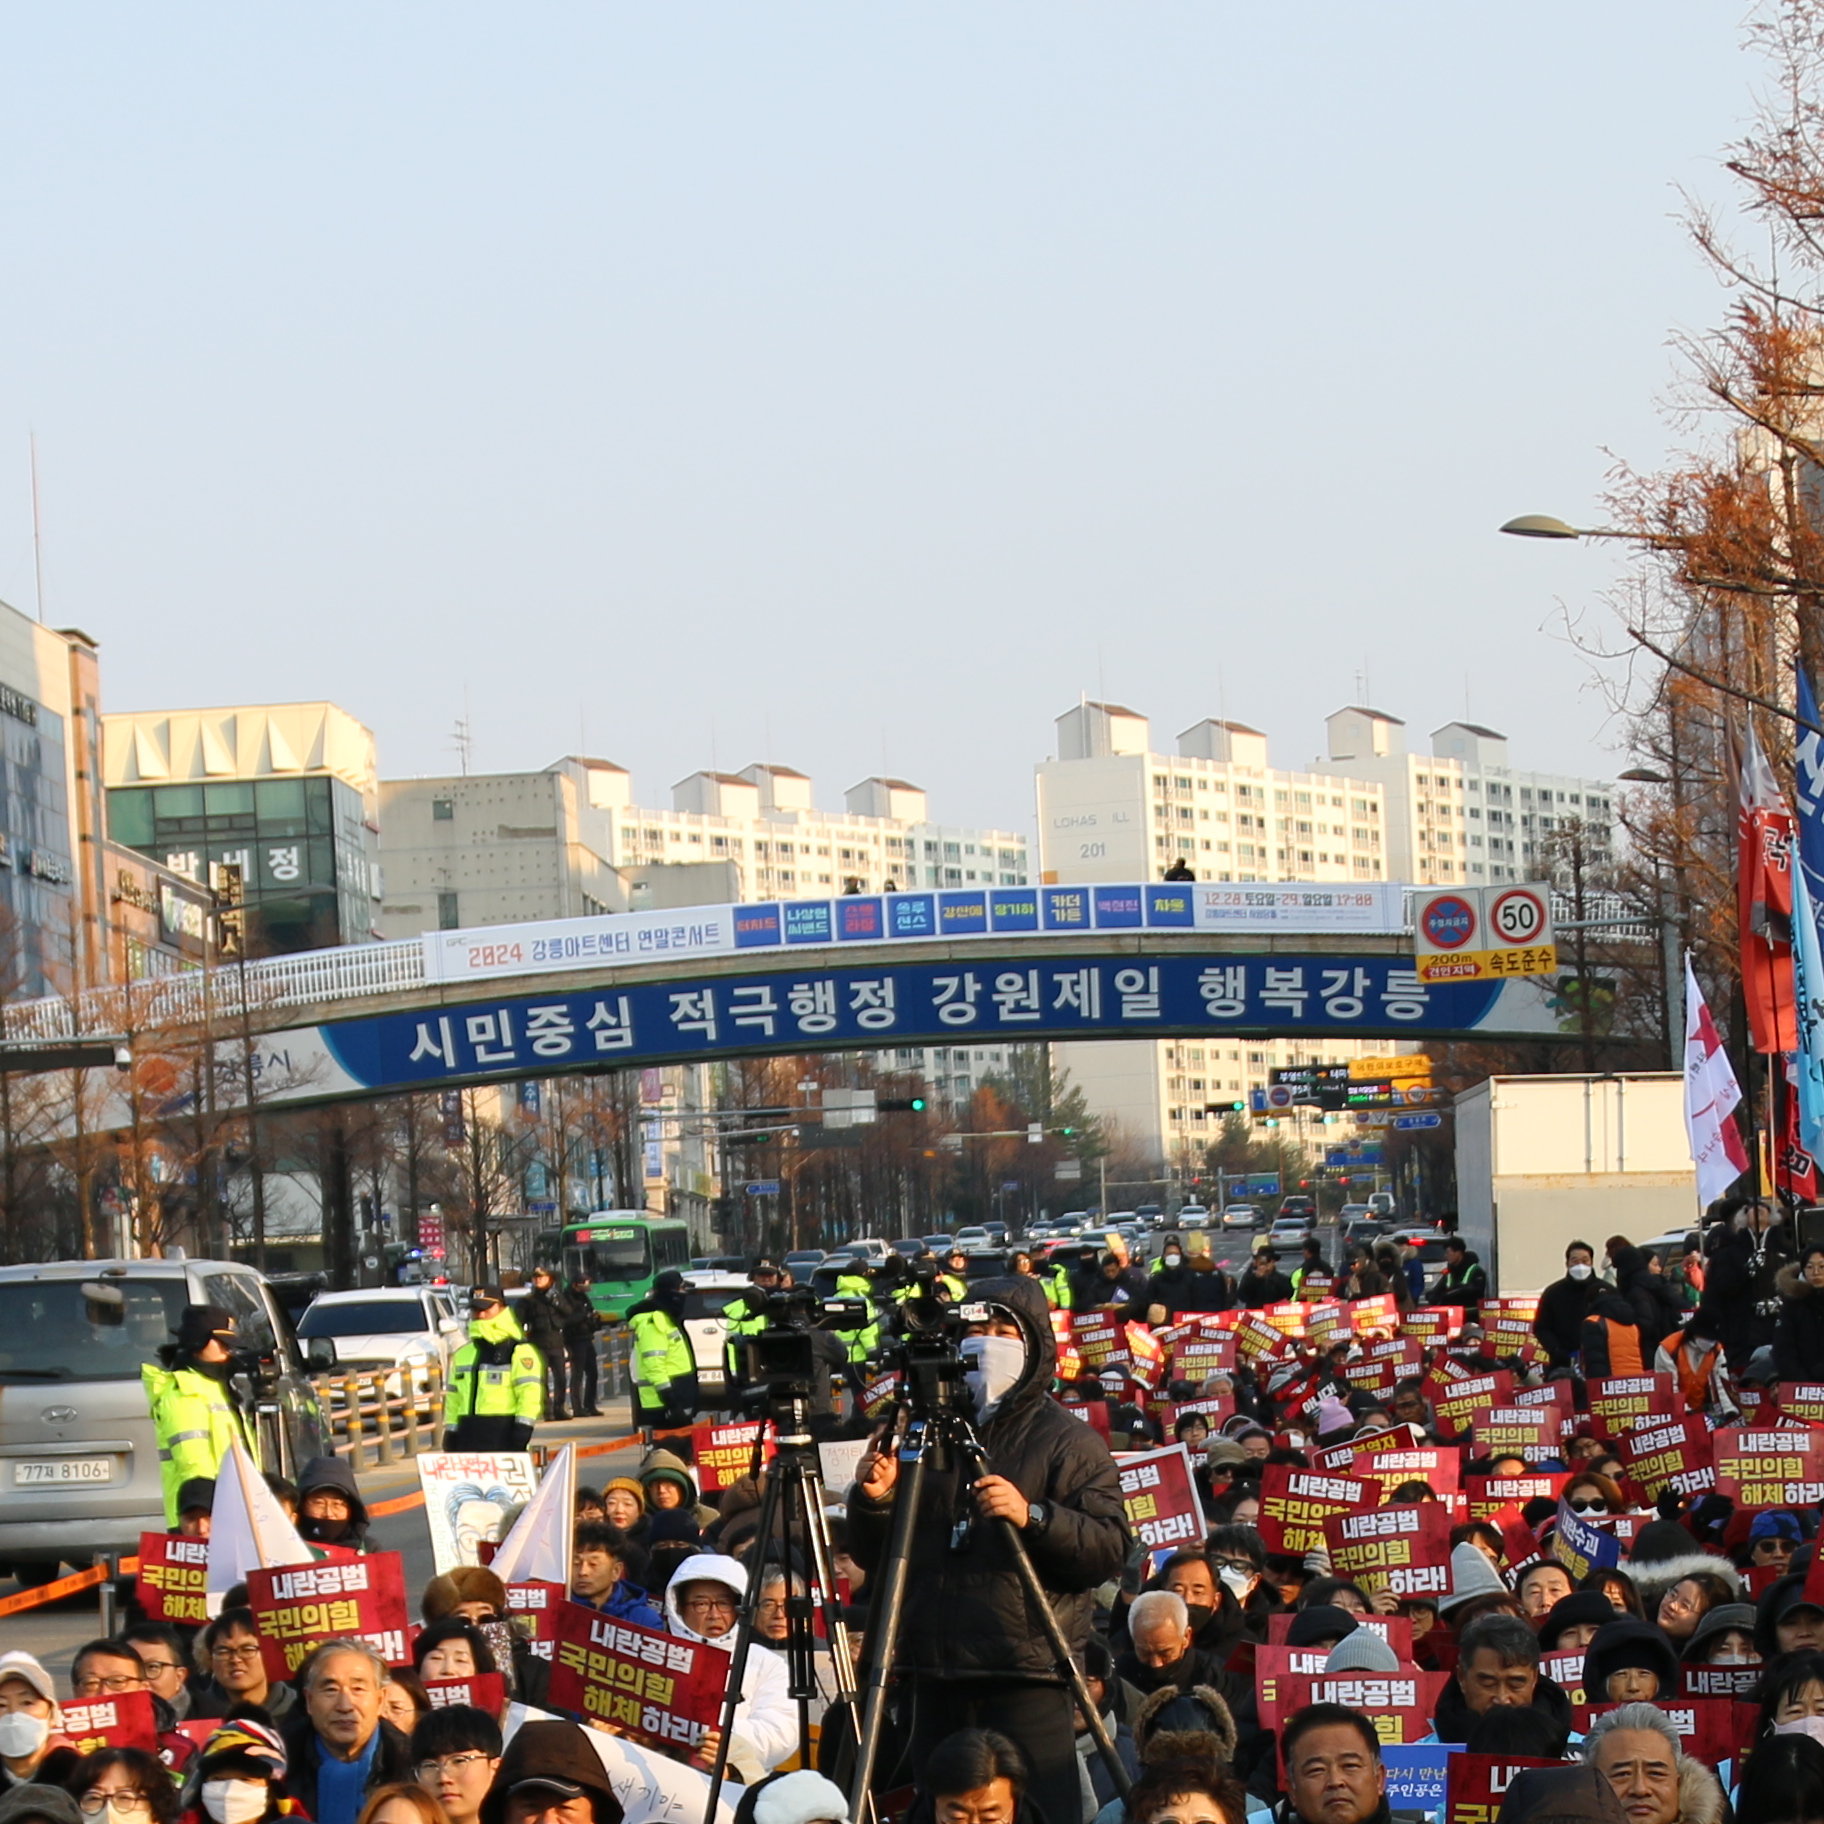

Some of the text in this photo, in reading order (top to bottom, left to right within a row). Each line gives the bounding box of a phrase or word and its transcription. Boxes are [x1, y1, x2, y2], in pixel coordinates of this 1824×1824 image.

[1080, 842, 1106, 858] 201
[1502, 903, 1534, 931] 50
[468, 922, 720, 968] 2024 강릉아트센터 연말콘서트
[1430, 954, 1472, 965] 200m
[1490, 948, 1552, 974] 속도준수
[408, 964, 1431, 1070] 시민중심 적극행정 강원제일 행복강릉
[1407, 1313, 1439, 1323] 내란공범
[1185, 1344, 1223, 1354] 내란공범
[1175, 1357, 1218, 1367] 국민의힘
[1346, 1363, 1383, 1378] 내란공범
[1445, 1377, 1495, 1397] 내란공범
[1601, 1376, 1655, 1394] 내란공범
[1436, 1395, 1492, 1417] 국민의힘
[1490, 1410, 1544, 1423] 내란공범
[1591, 1398, 1649, 1415] 국민의힘
[1476, 1428, 1538, 1443] 국민의힘
[1631, 1425, 1686, 1455] 내란공범
[1738, 1433, 1810, 1452] 내란공범
[59, 1460, 103, 1482] 8106
[1374, 1451, 1438, 1470] 내란공범
[1628, 1452, 1683, 1482] 국민의힘
[1719, 1458, 1803, 1479] 국민의힘
[1289, 1475, 1363, 1501] 내란공범
[1486, 1479, 1551, 1498] 내란공범
[1343, 1509, 1418, 1540] 내란공범
[1331, 1540, 1411, 1573] 국민의힘
[271, 1565, 368, 1599] 내란공범
[257, 1597, 358, 1637] 국민의힘
[591, 1622, 694, 1674] 내란공범
[559, 1639, 673, 1702] 국민의힘
[1310, 1679, 1415, 1706] 내란공범
